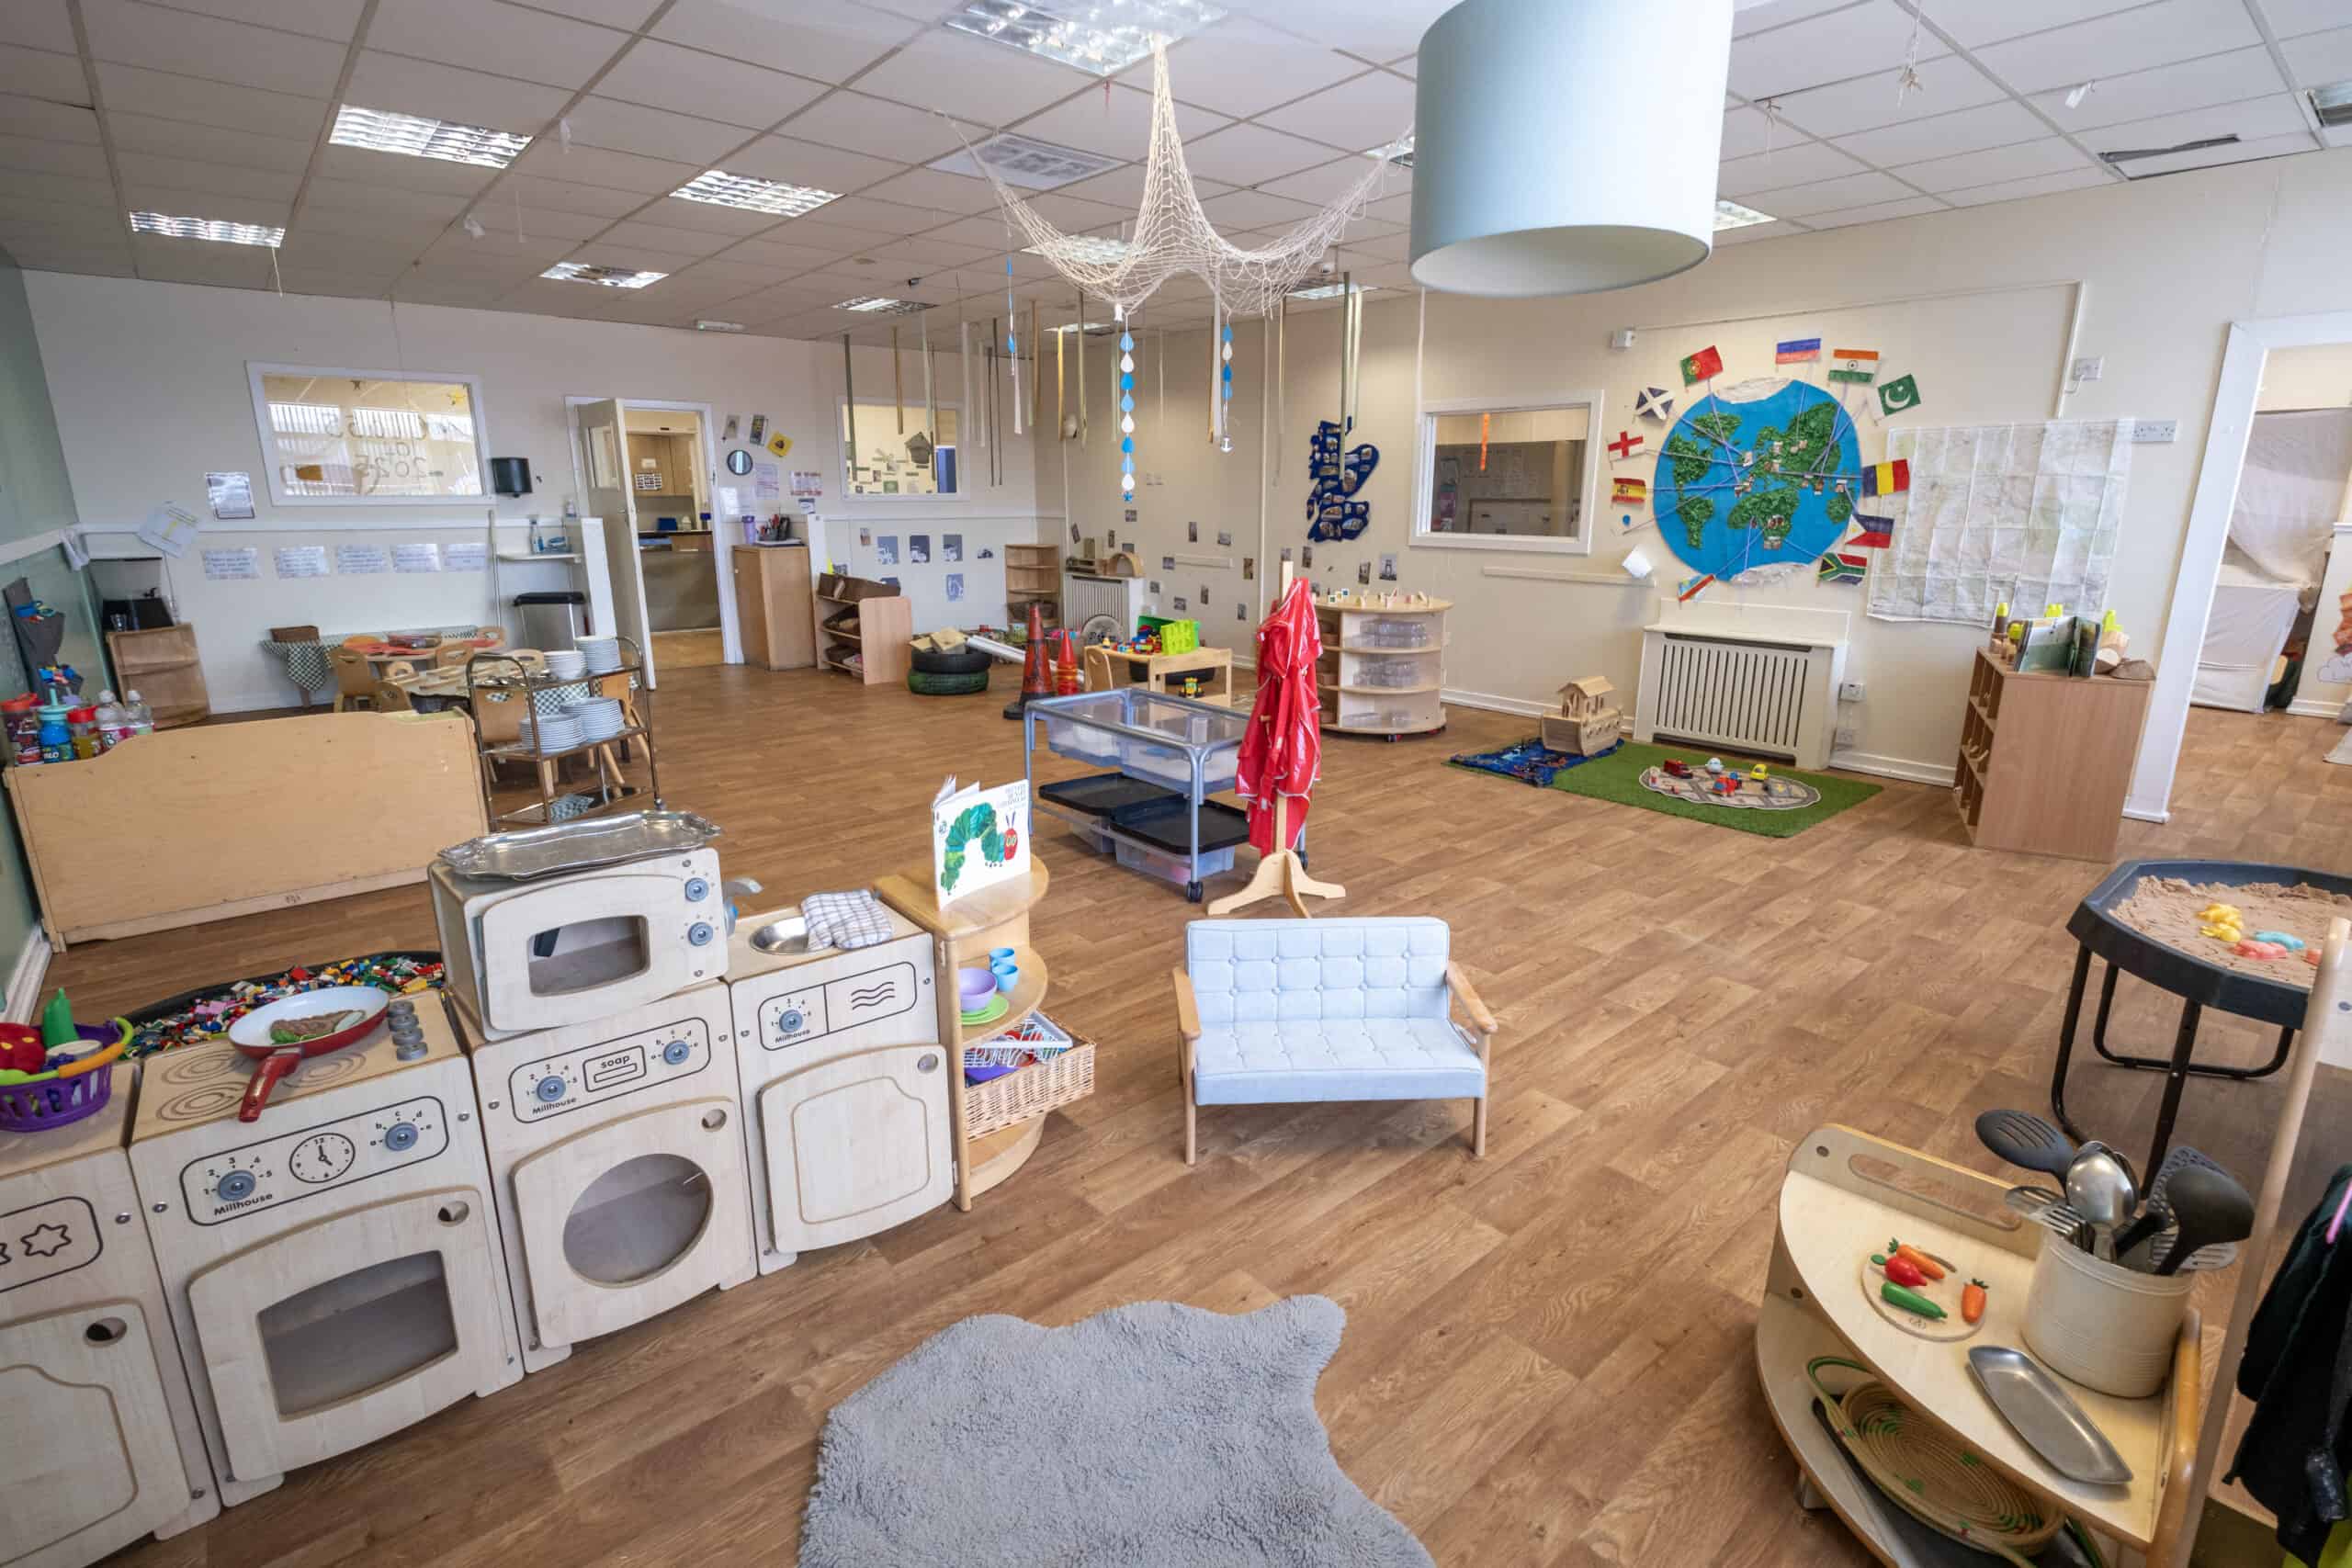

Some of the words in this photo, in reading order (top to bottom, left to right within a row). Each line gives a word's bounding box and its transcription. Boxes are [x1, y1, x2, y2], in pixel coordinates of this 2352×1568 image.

[600, 1055, 630, 1069] soap
[532, 1098, 576, 1115] Millhouse
[314, 1137, 324, 1145] 12
[254, 1156, 261, 1164] 4
[266, 1169, 273, 1178] 5
[213, 1193, 273, 1216] Millhouse
